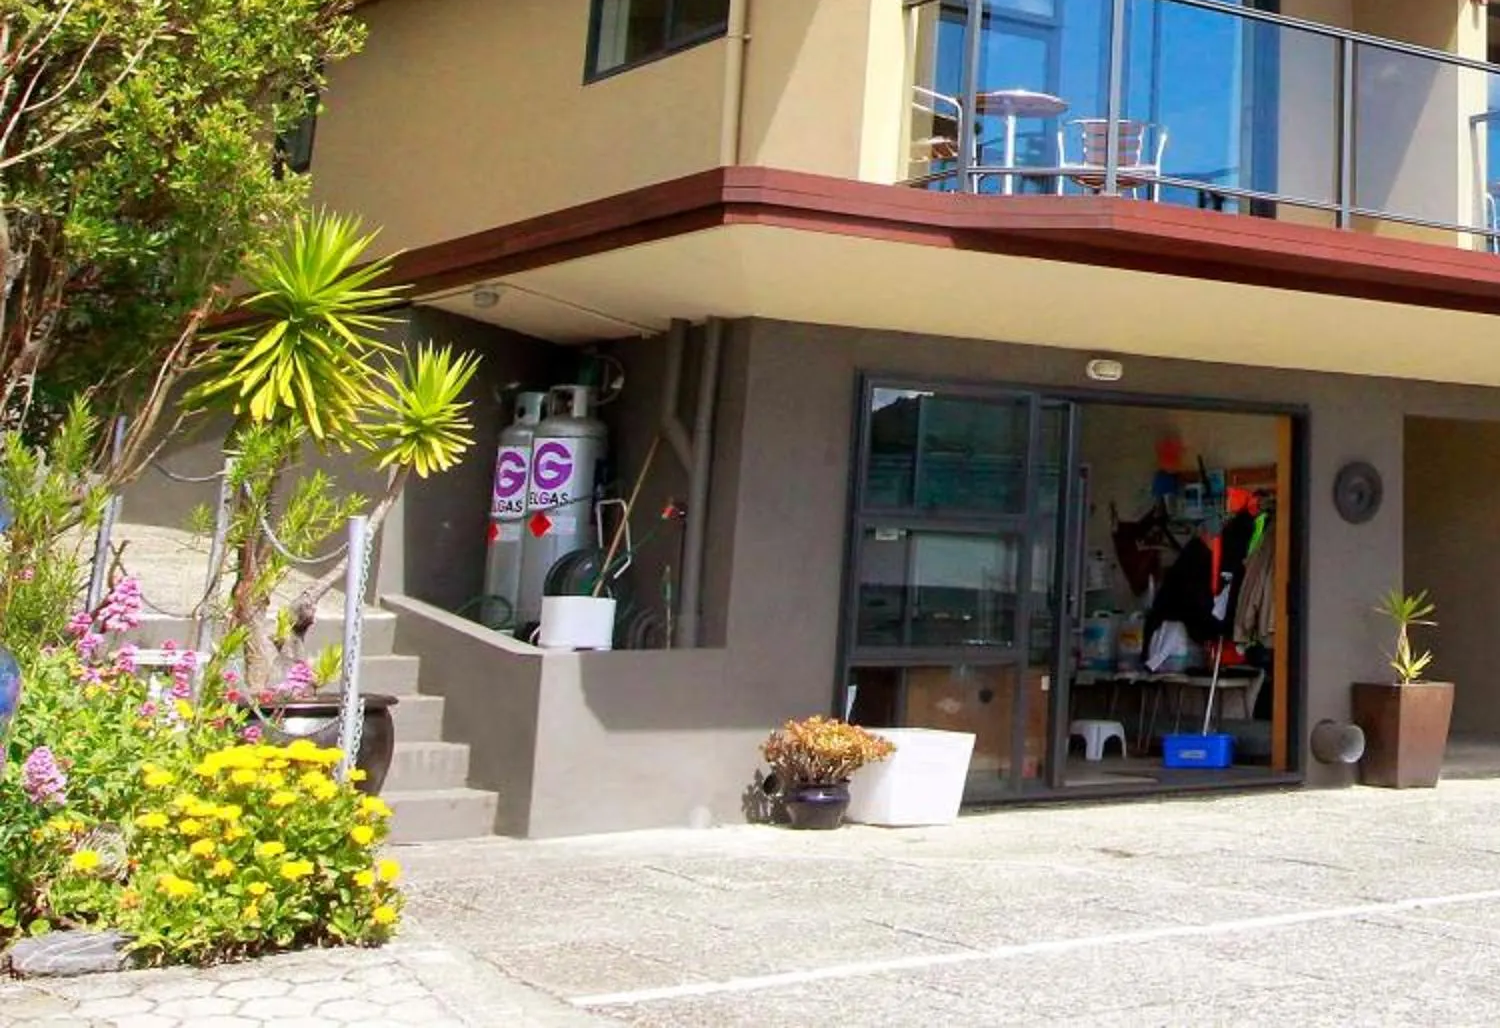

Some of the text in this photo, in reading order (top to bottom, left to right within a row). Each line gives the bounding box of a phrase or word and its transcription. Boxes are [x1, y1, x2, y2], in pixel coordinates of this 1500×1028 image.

[495, 451, 526, 497] G
[534, 442, 573, 490] G
[529, 491, 569, 506] ELGAS
